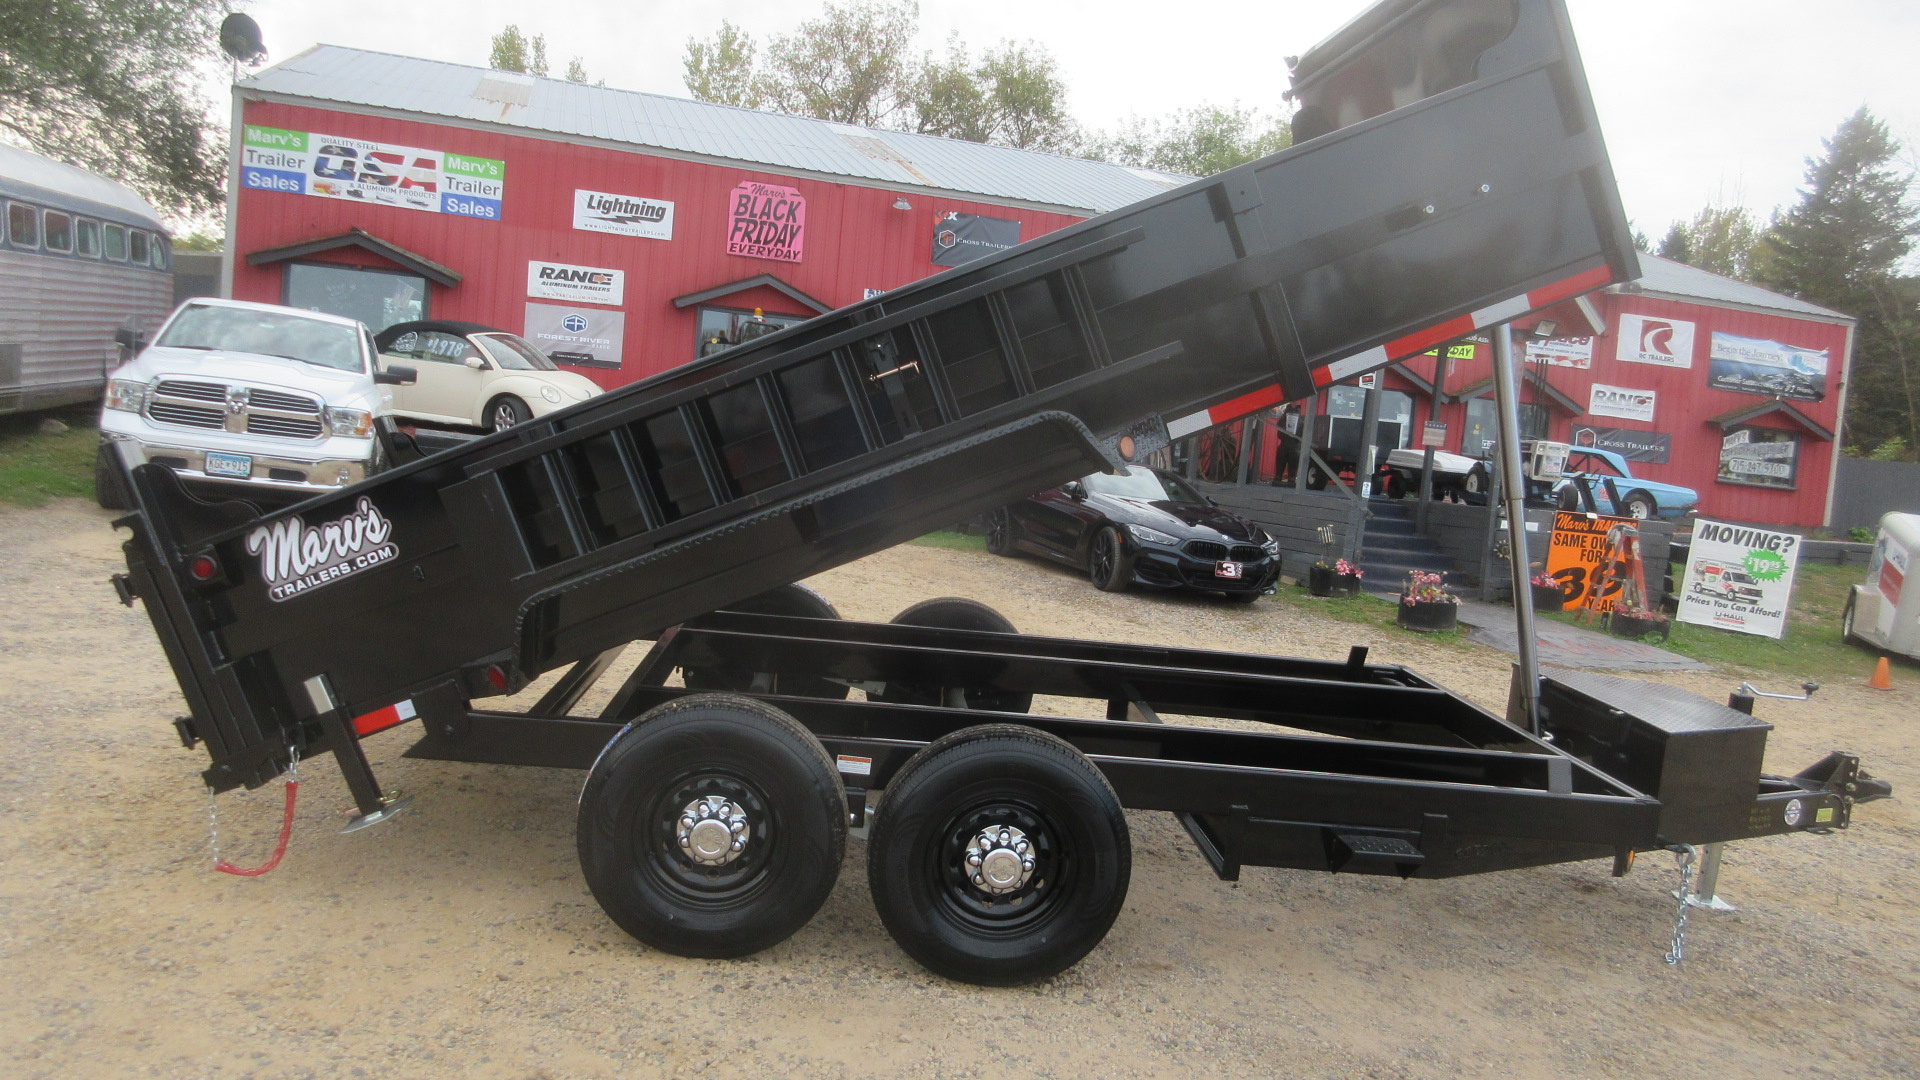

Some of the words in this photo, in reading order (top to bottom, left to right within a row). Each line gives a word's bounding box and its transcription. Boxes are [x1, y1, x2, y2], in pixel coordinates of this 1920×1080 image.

[247, 128, 302, 147] Marv's
[321, 137, 355, 148] QUALITY
[357, 142, 380, 152] STEEL
[246, 149, 306, 168] Trailer
[448, 157, 498, 175] Marv's
[247, 171, 300, 192] Sales
[446, 176, 500, 196] Trailer
[357, 184, 397, 194] ALUMINUM
[399, 189, 437, 200] PRODUCTS
[447, 198, 495, 218] Sales
[587, 194, 667, 219] Lightning
[734, 193, 802, 224] BLACK
[730, 217, 802, 248] FRIDAY
[729, 243, 802, 260] EVERYDAY
[541, 281, 579, 290] ALUMINUM
[580, 284, 612, 293] TRAILERS
[537, 333, 578, 342] FOREST
[580, 337, 610, 345] RIVER
[1648, 354, 1675, 363] TRAILERS
[1717, 343, 1738, 355] Begin
[1739, 347, 1752, 357] the
[1597, 440, 1625, 448] CROSS
[1627, 441, 1665, 452] TRAILERS
[1557, 513, 1590, 531] Marv's
[250, 500, 388, 582] Marv's
[1553, 533, 1588, 548] SAME
[1698, 523, 1795, 553] MOVING?
[1580, 549, 1603, 563] FOR
[274, 546, 393, 598] TRAILERS.COM
[1685, 594, 1710, 606] Prices
[1713, 601, 1729, 609] You
[1730, 603, 1747, 613] Can
[1748, 606, 1781, 618] Afford!
